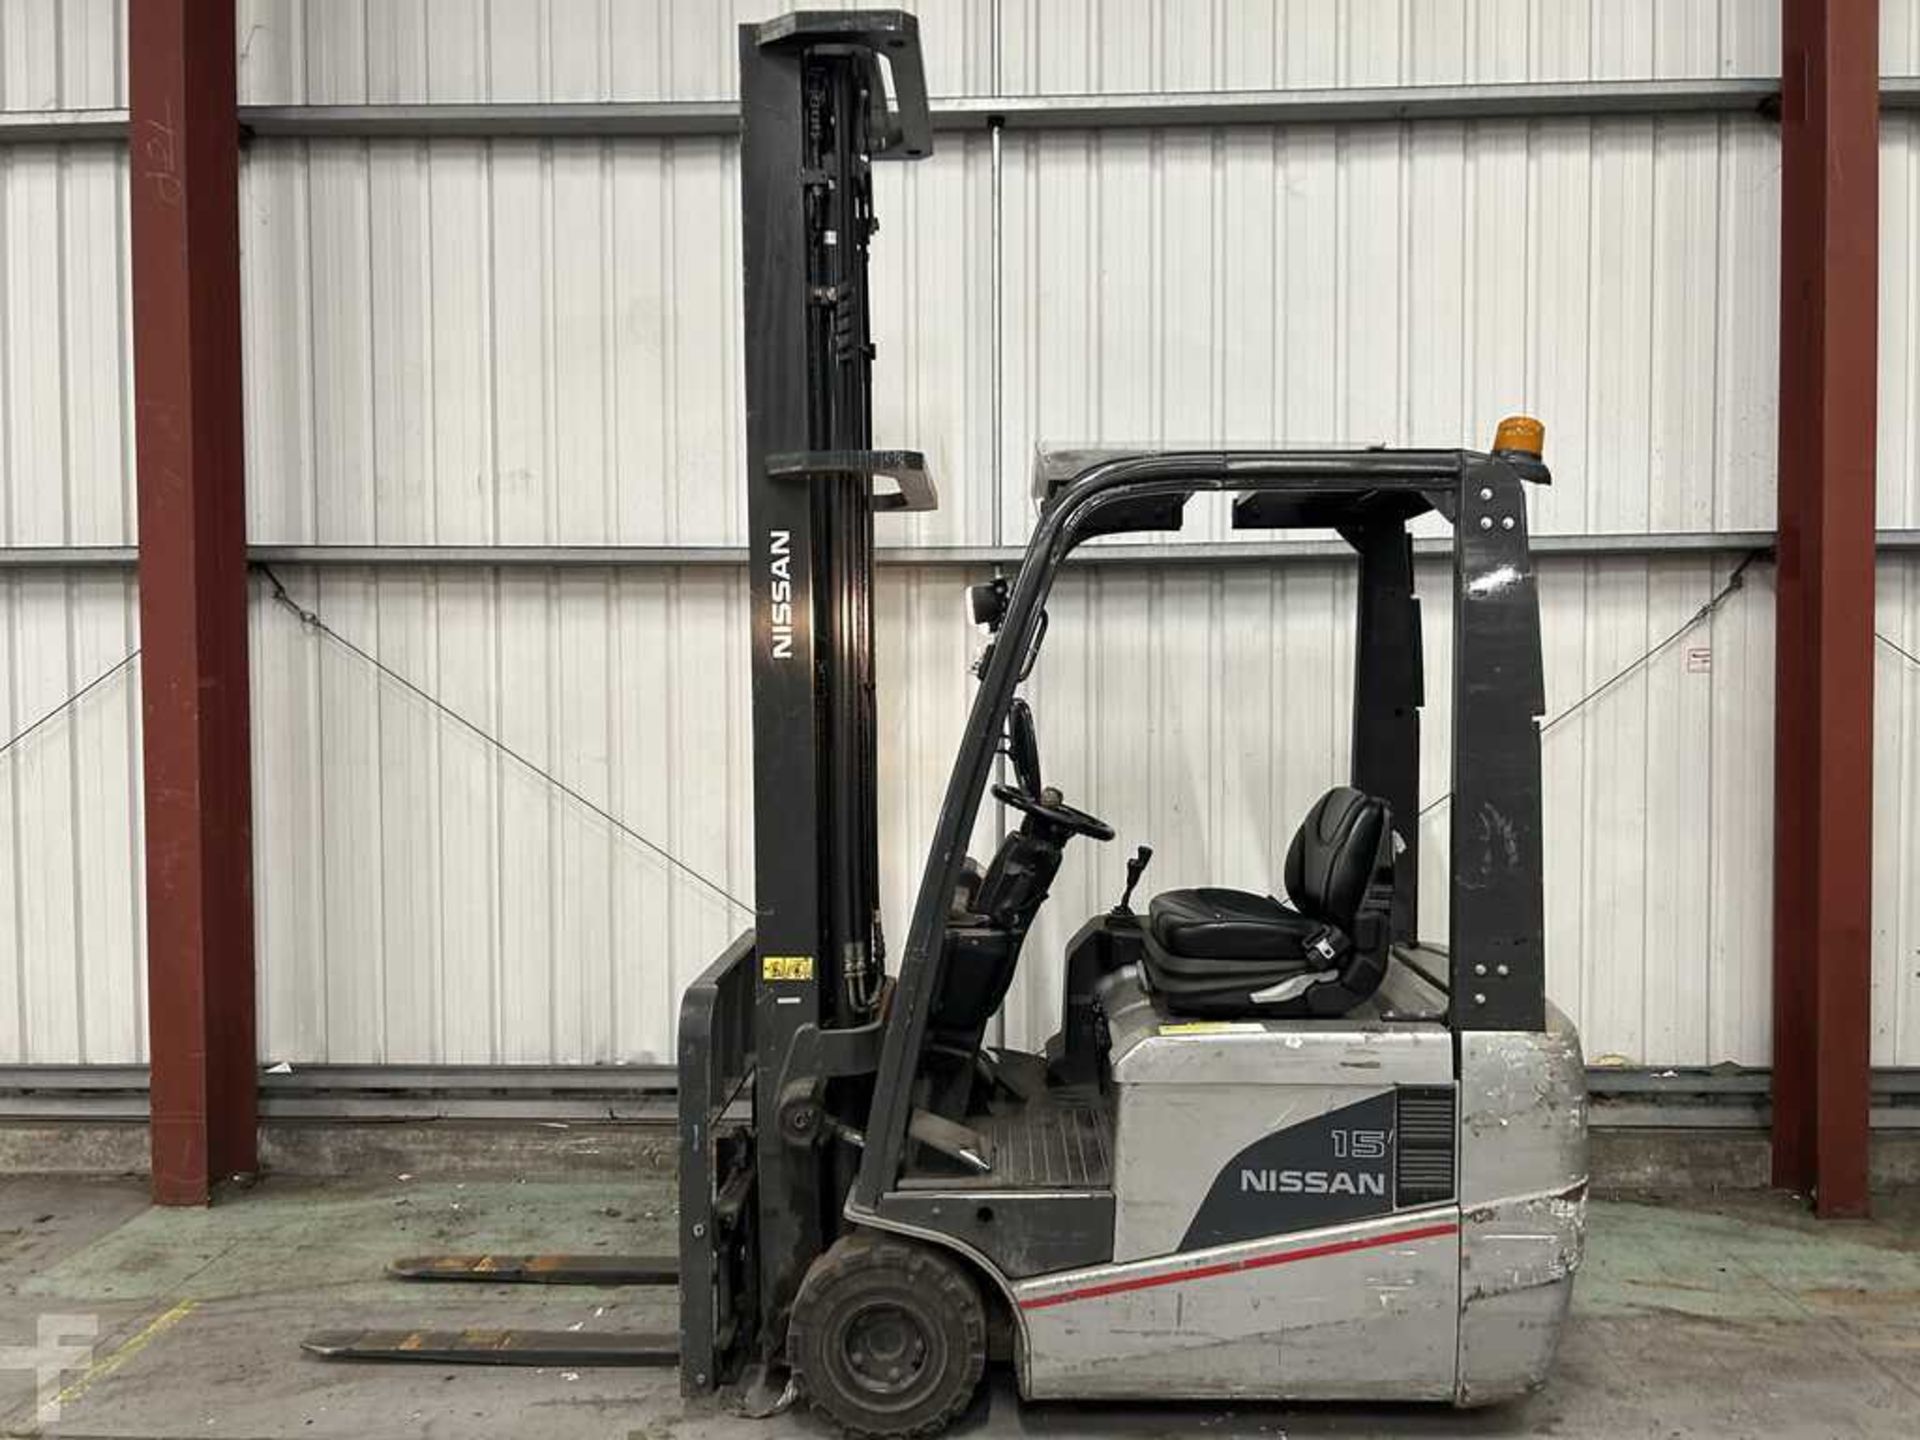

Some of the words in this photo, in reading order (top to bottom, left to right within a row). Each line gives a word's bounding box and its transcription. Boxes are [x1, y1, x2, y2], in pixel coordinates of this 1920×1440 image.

[770, 530, 793, 659] NISSAN
[1331, 1129, 1385, 1158] 15
[1240, 1169, 1386, 1195] NISSAN
